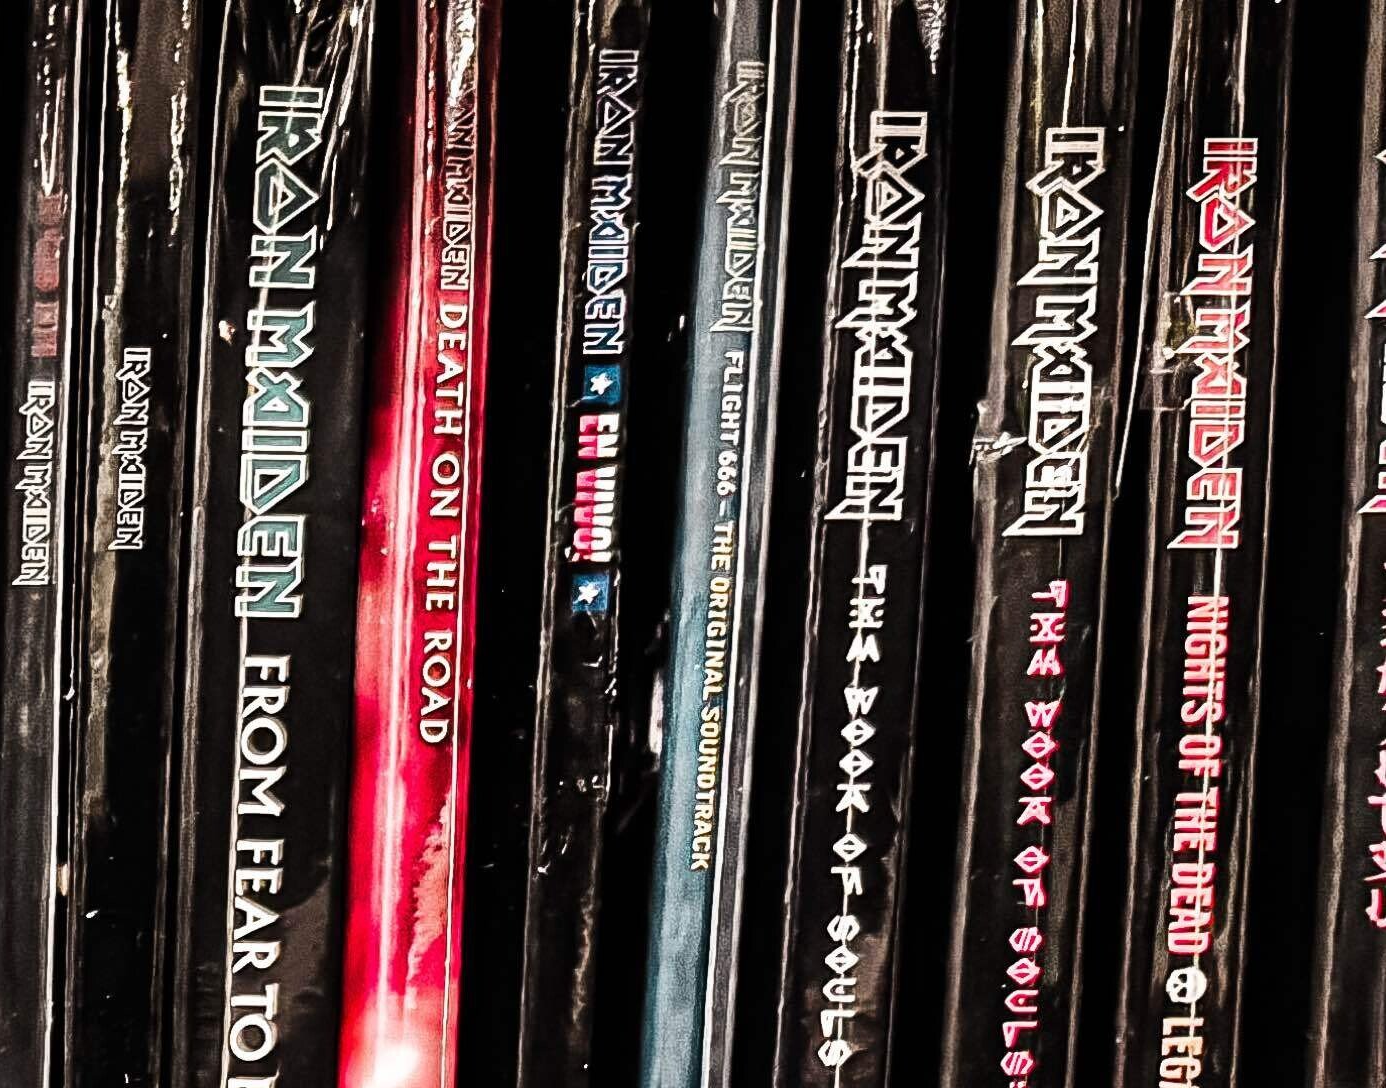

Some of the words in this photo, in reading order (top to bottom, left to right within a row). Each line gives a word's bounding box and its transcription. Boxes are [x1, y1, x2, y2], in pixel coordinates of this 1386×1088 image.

[591, 49, 640, 166] IRON
[723, 60, 768, 170] IRON
[248, 85, 325, 290] IRON
[441, 156, 472, 292] MAIDEN
[840, 110, 928, 270] IRON
[1016, 128, 1108, 285] IRON
[1178, 138, 1260, 300] IRON
[583, 174, 633, 356] MAIDEN
[710, 172, 763, 334] MAIDEN
[18, 380, 56, 460] IRON
[113, 348, 152, 425] IRON
[433, 302, 468, 436] DEATH
[718, 350, 746, 444] FLIGHT
[824, 272, 917, 521] MAIDEN
[1000, 286, 1098, 540] MAIDEN
[1166, 301, 1251, 550] MAIDEN
[108, 428, 149, 550] MAIDEN
[235, 302, 315, 620] MAIDEN
[430, 452, 461, 518] ON
[577, 413, 621, 460] EN
[716, 450, 740, 496] 666
[12, 464, 56, 588] MAIDEN
[426, 534, 460, 612] THE
[572, 465, 617, 563] VIVO!
[708, 522, 736, 572] THE
[700, 578, 733, 700] ORIGINAL
[845, 566, 889, 662] THE
[1026, 580, 1068, 676] THE
[1180, 595, 1228, 722] NIGHTS
[236, 652, 290, 815] FROM
[420, 630, 454, 746] ROAD
[690, 702, 723, 872] SOUNDTRACK
[835, 687, 881, 813] BOOK
[1018, 700, 1061, 826] BOOK
[1176, 734, 1218, 778] OF
[828, 834, 873, 895] OF
[1012, 846, 1050, 906] OF
[1173, 788, 1218, 852] THE
[231, 840, 284, 968] FEAR
[1168, 862, 1213, 955] DEAD
[228, 982, 280, 1063] TO
[818, 915, 863, 1068] SOULS
